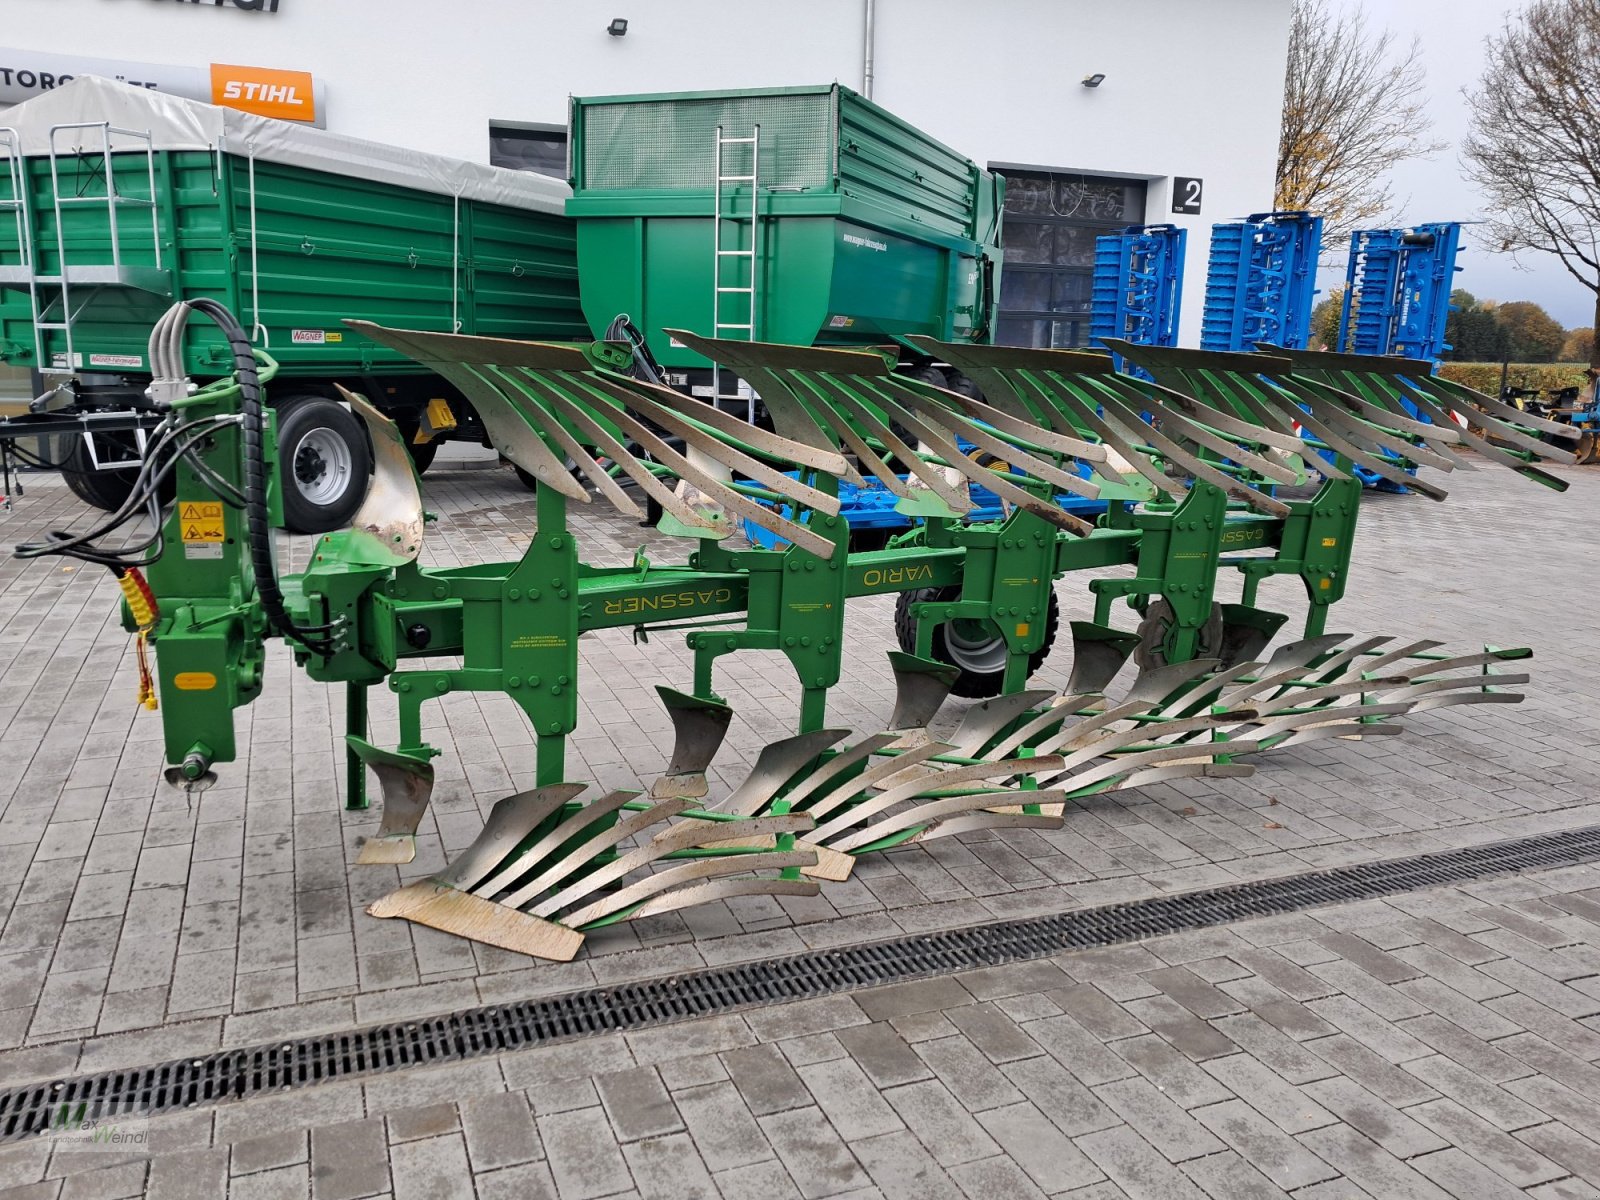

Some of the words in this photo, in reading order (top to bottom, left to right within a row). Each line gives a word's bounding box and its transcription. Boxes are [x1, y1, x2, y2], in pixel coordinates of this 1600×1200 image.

[223, 80, 304, 105] STIHL
[1185, 180, 1201, 206] 2
[863, 564, 933, 587] VARIO
[604, 588, 731, 615] GASSNER
